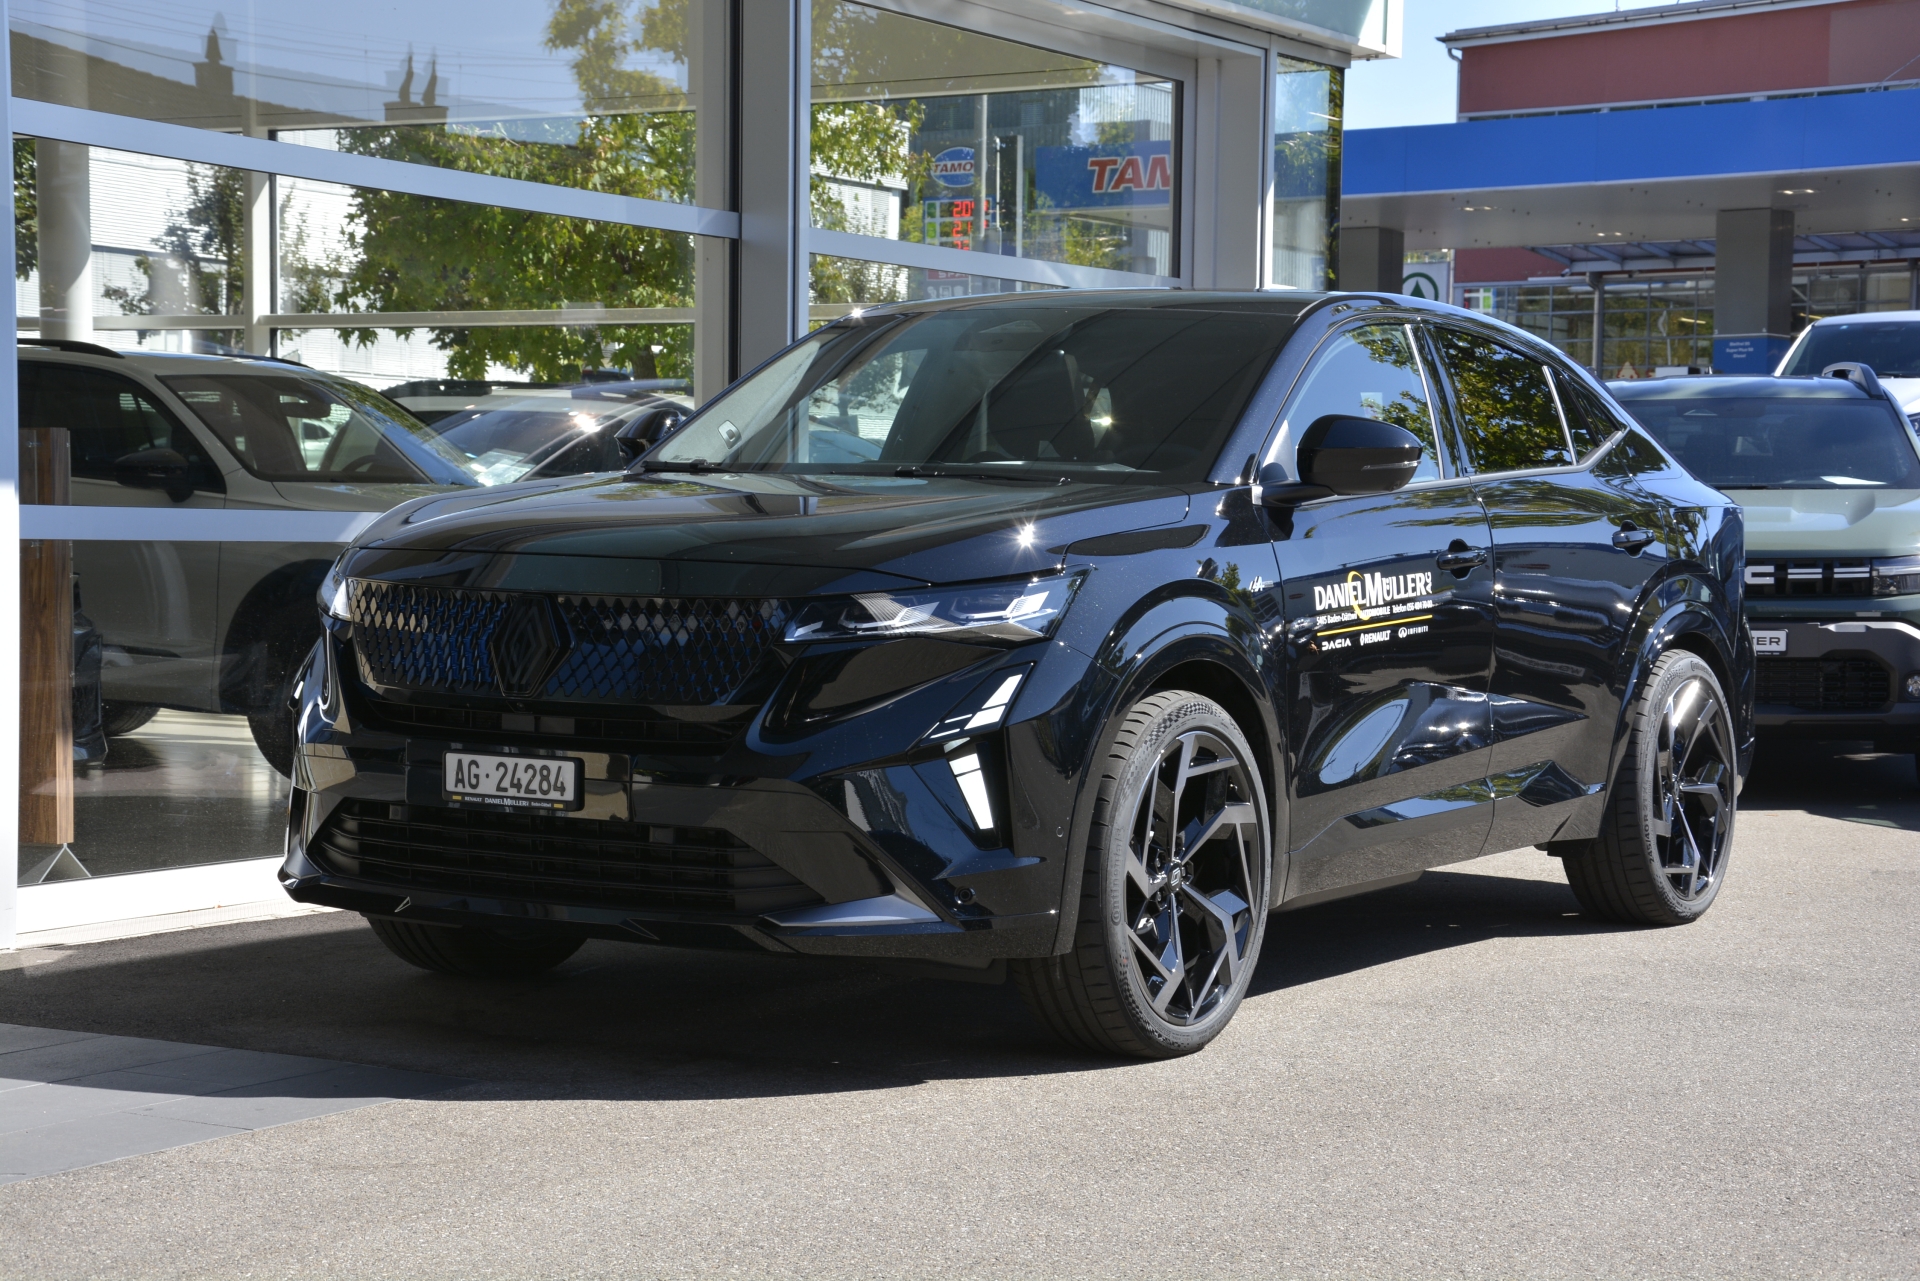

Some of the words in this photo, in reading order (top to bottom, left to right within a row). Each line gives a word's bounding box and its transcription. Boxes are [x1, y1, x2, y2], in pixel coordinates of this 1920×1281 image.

[1087, 154, 1171, 193] TAM
[1321, 638, 1352, 651] DACIA
[1364, 630, 1391, 644] RENAULT
[1407, 625, 1429, 635] INFINITI
